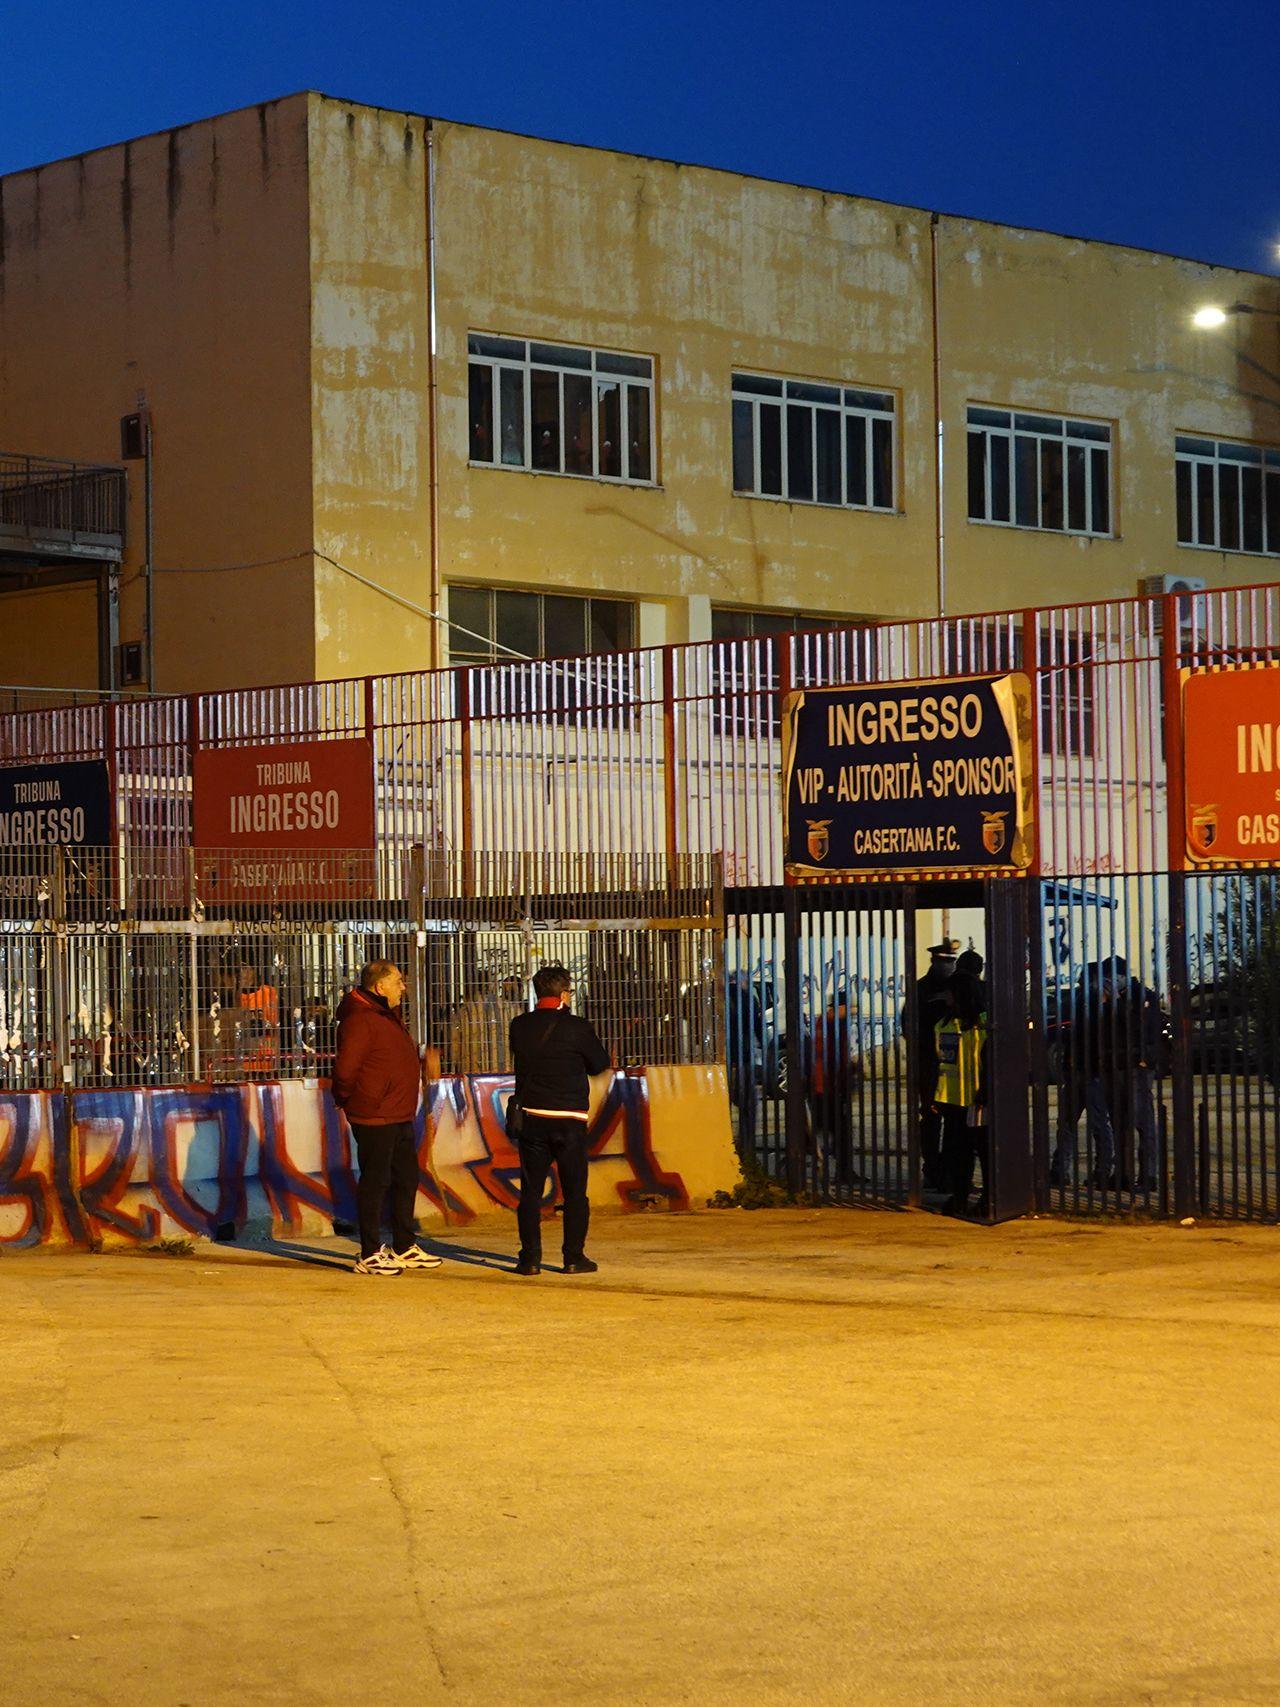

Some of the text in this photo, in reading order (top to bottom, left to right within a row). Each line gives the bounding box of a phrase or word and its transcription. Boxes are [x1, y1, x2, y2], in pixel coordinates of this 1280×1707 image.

[828, 693, 983, 747] INGRESSO
[1237, 723, 1280, 773] IN
[256, 761, 311, 786] TRIBUNA
[797, 768, 824, 804] VIP
[837, 752, 923, 802] AUTORITÀ
[14, 780, 61, 804] TRIBUNA
[230, 790, 339, 833] INGRESSO
[854, 825, 960, 855] CASERTANA F.C.
[347, 919, 375, 934] NON
